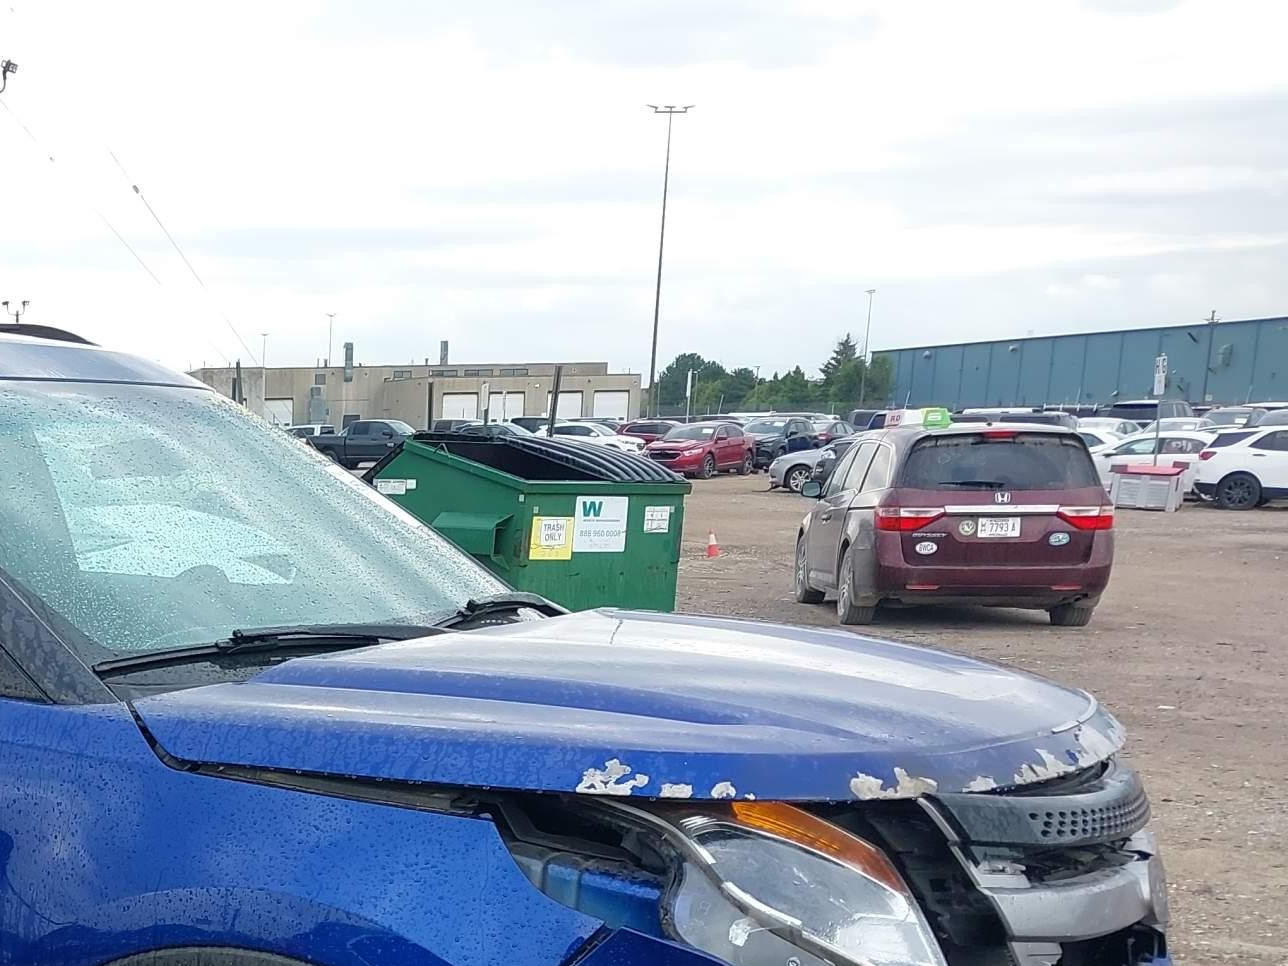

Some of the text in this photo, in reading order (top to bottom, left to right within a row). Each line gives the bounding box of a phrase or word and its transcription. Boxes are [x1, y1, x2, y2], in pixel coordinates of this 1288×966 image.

[582, 501, 603, 517] W
[543, 523, 565, 532] TRASH
[989, 522, 1009, 532] 7793
[544, 534, 562, 542] ONLY
